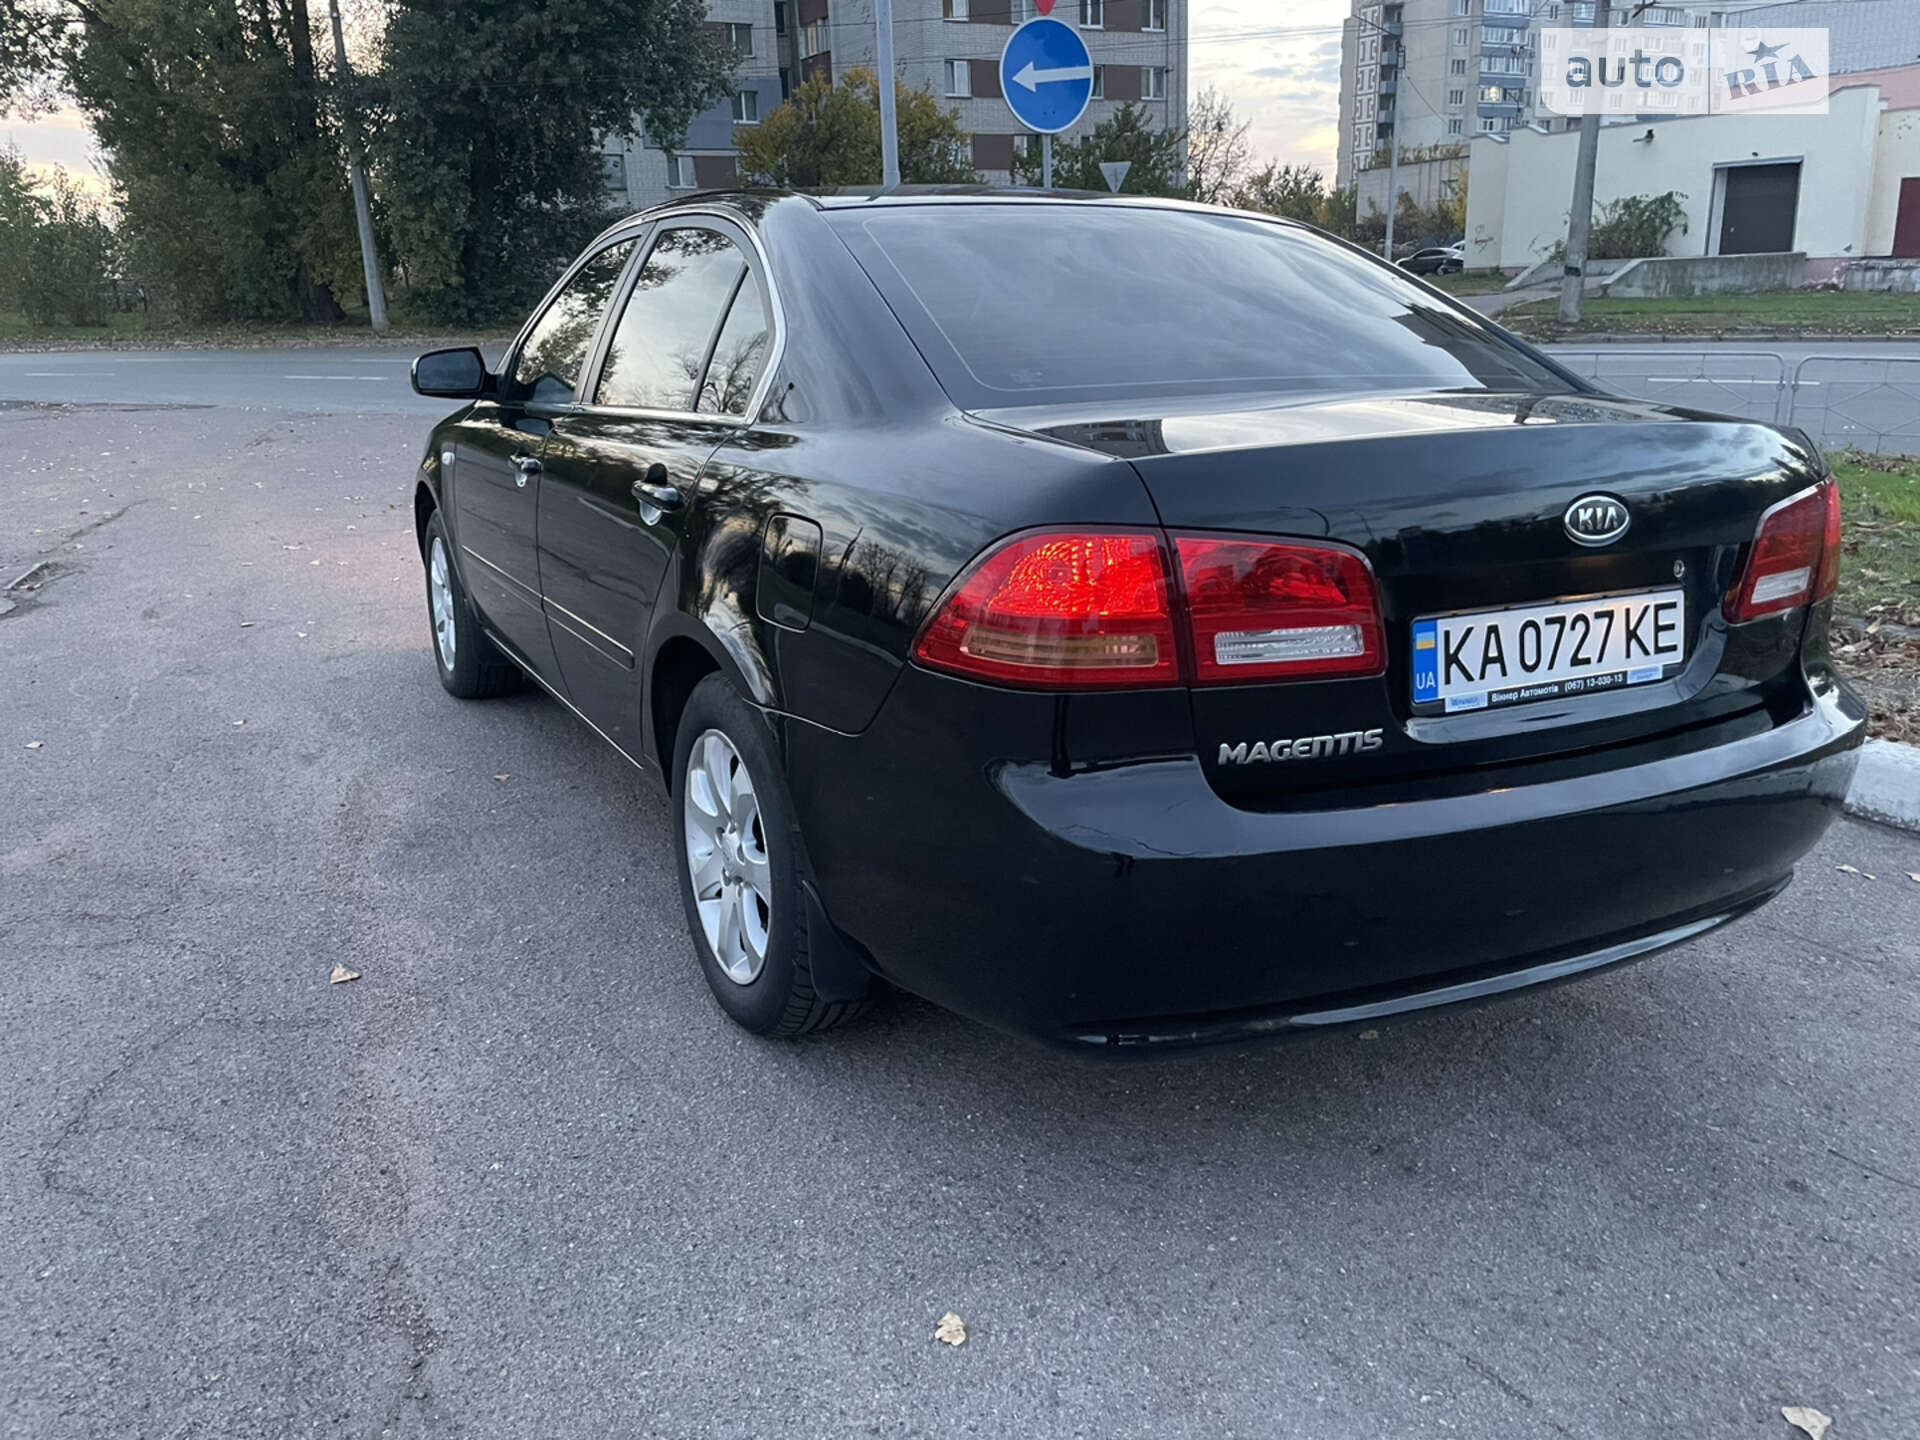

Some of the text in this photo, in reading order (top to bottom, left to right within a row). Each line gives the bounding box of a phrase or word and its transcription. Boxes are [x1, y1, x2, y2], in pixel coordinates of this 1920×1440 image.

[1578, 506, 1619, 530] KIA
[1444, 601, 1678, 685] KA 0727 KE
[1416, 671, 1436, 690] UA
[1217, 728, 1384, 766] MAGENTIS
